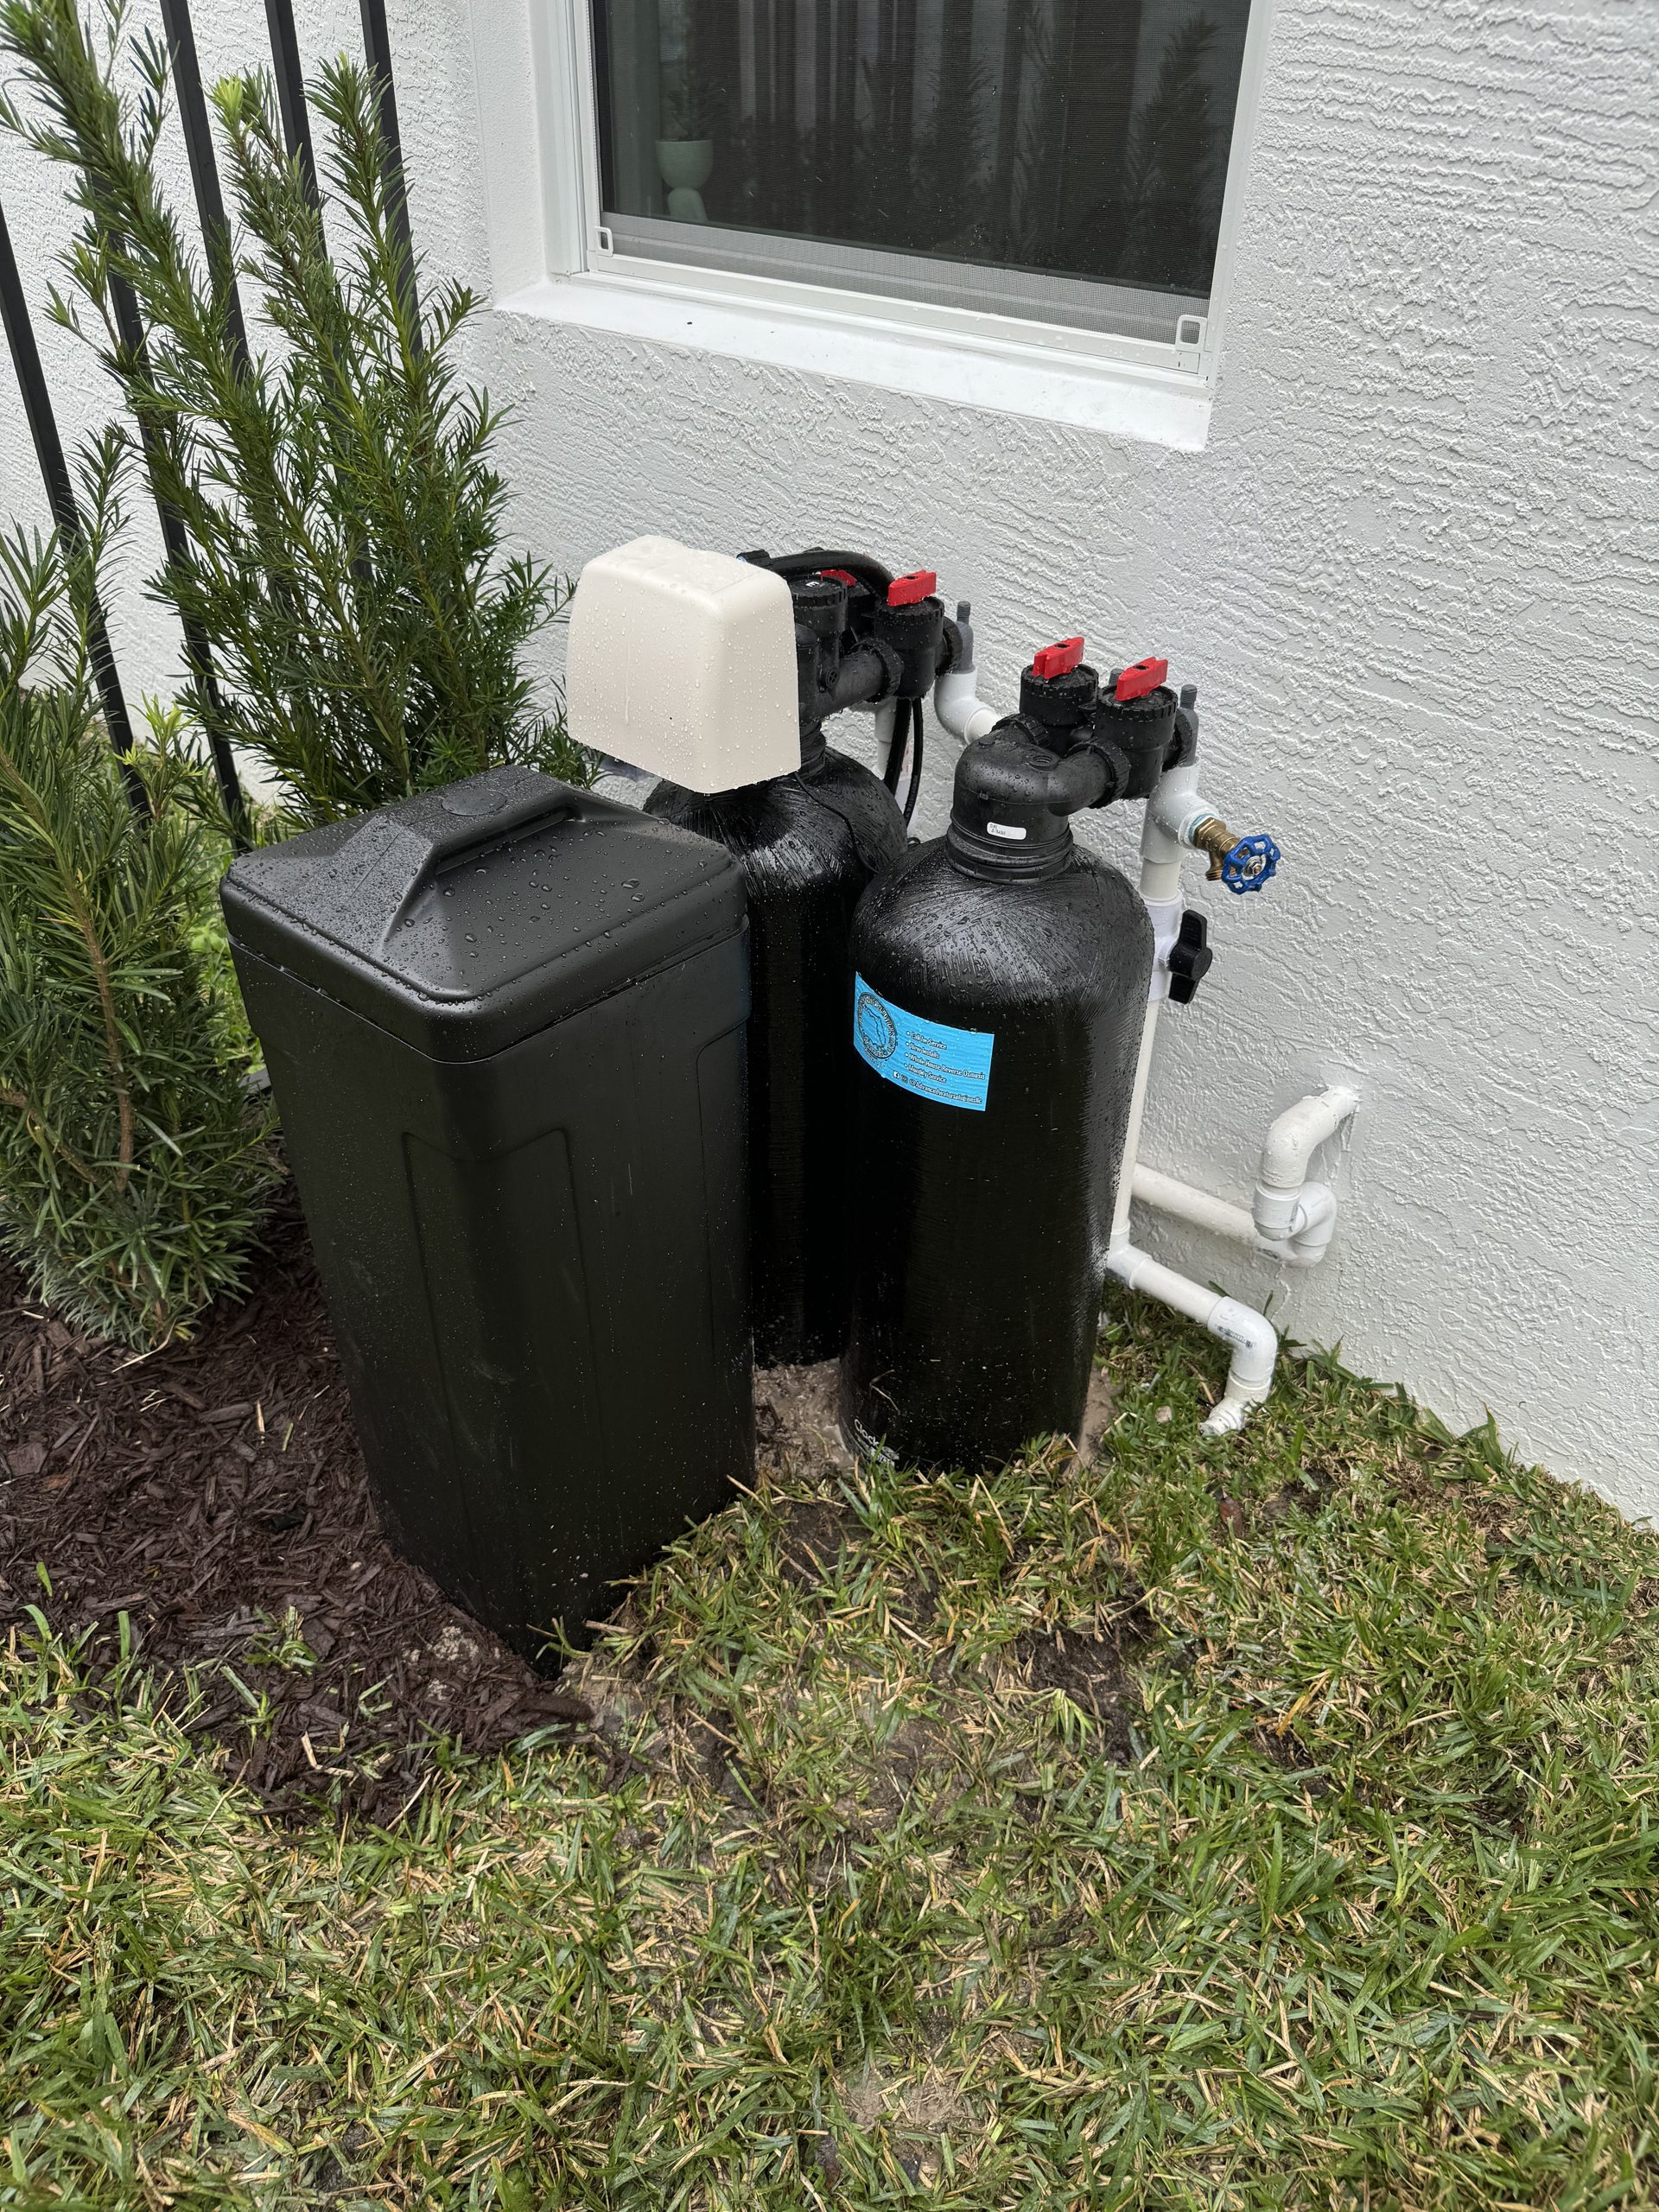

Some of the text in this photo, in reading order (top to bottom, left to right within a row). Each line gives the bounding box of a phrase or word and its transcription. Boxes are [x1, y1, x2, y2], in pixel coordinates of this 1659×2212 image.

[910, 1041, 940, 1059] New Installs
[928, 1039, 947, 1050] Service
[909, 1052, 986, 1080] Whole House Reverse Osmosis
[927, 1071, 947, 1084] Service
[854, 1419, 880, 1448] Clack
